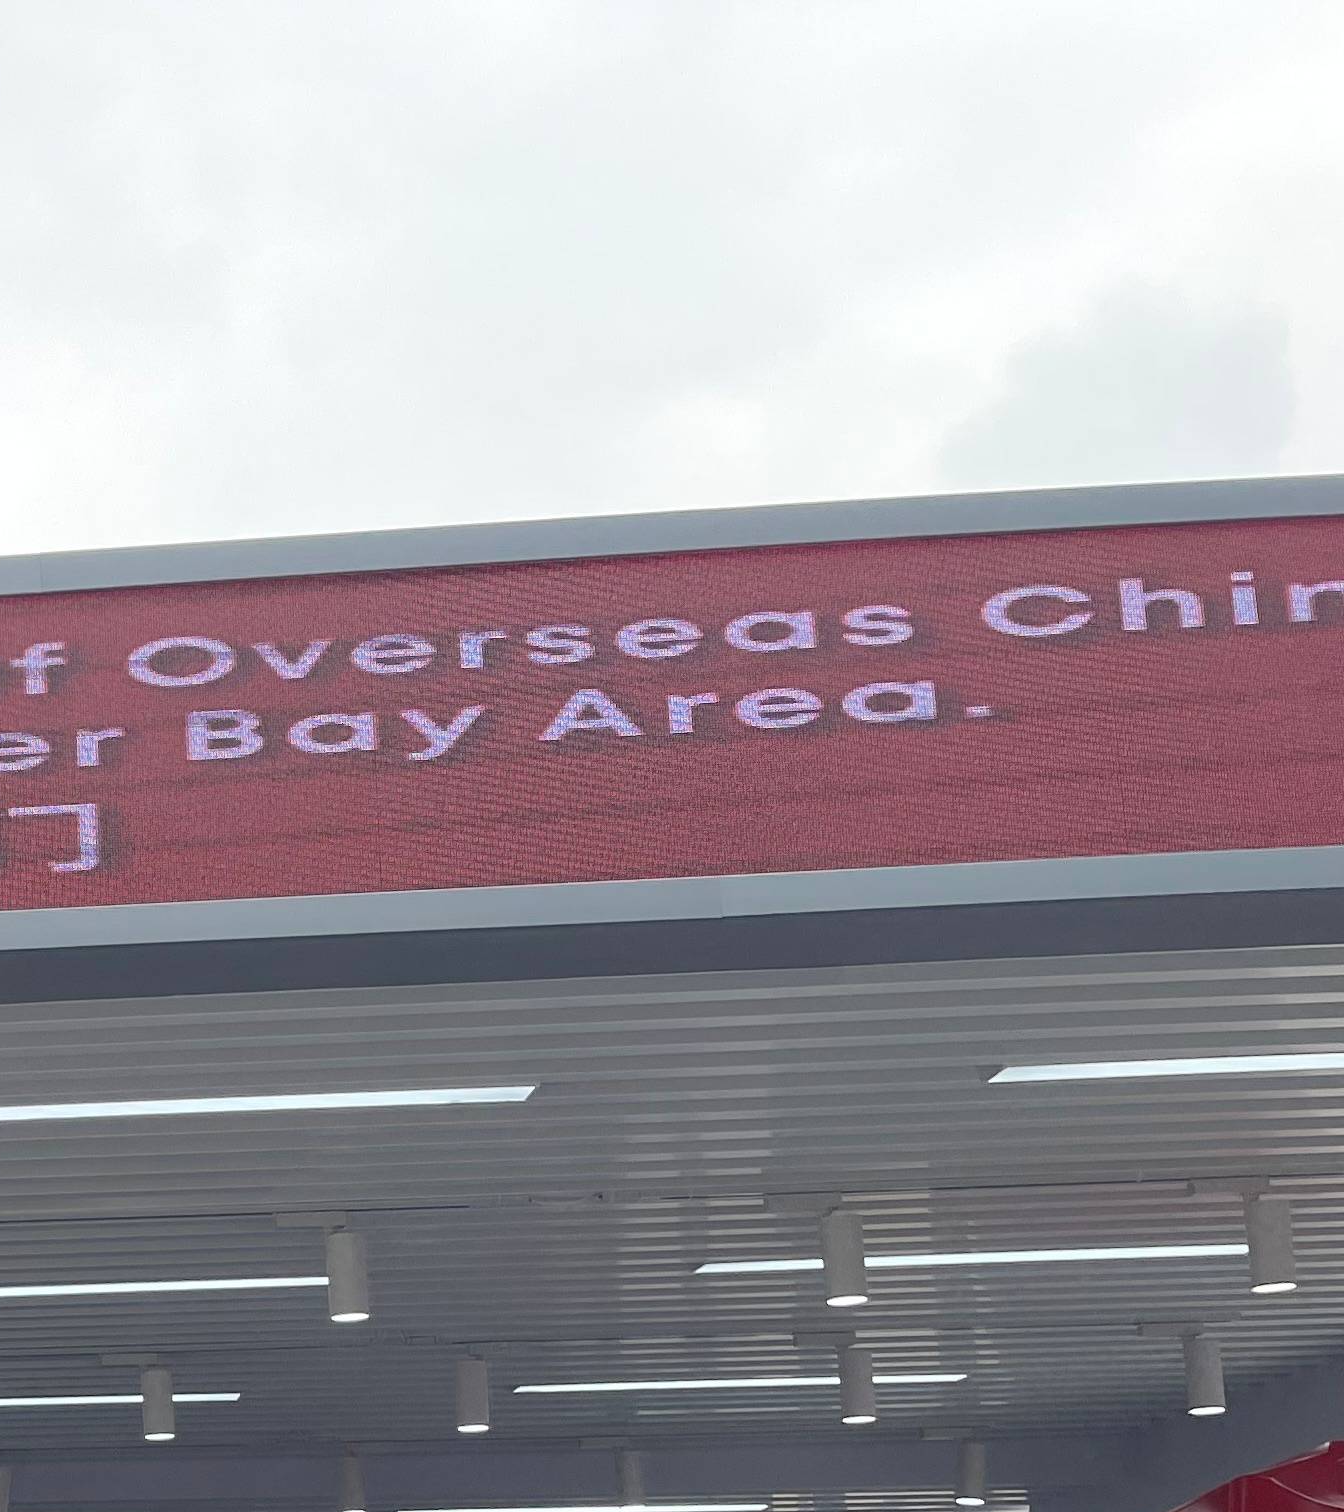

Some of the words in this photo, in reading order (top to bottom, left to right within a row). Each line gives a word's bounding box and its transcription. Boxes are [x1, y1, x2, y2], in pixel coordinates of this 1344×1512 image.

[127, 604, 915, 688] Overseas
[185, 703, 486, 762] Bay
[538, 680, 993, 742] Area.
